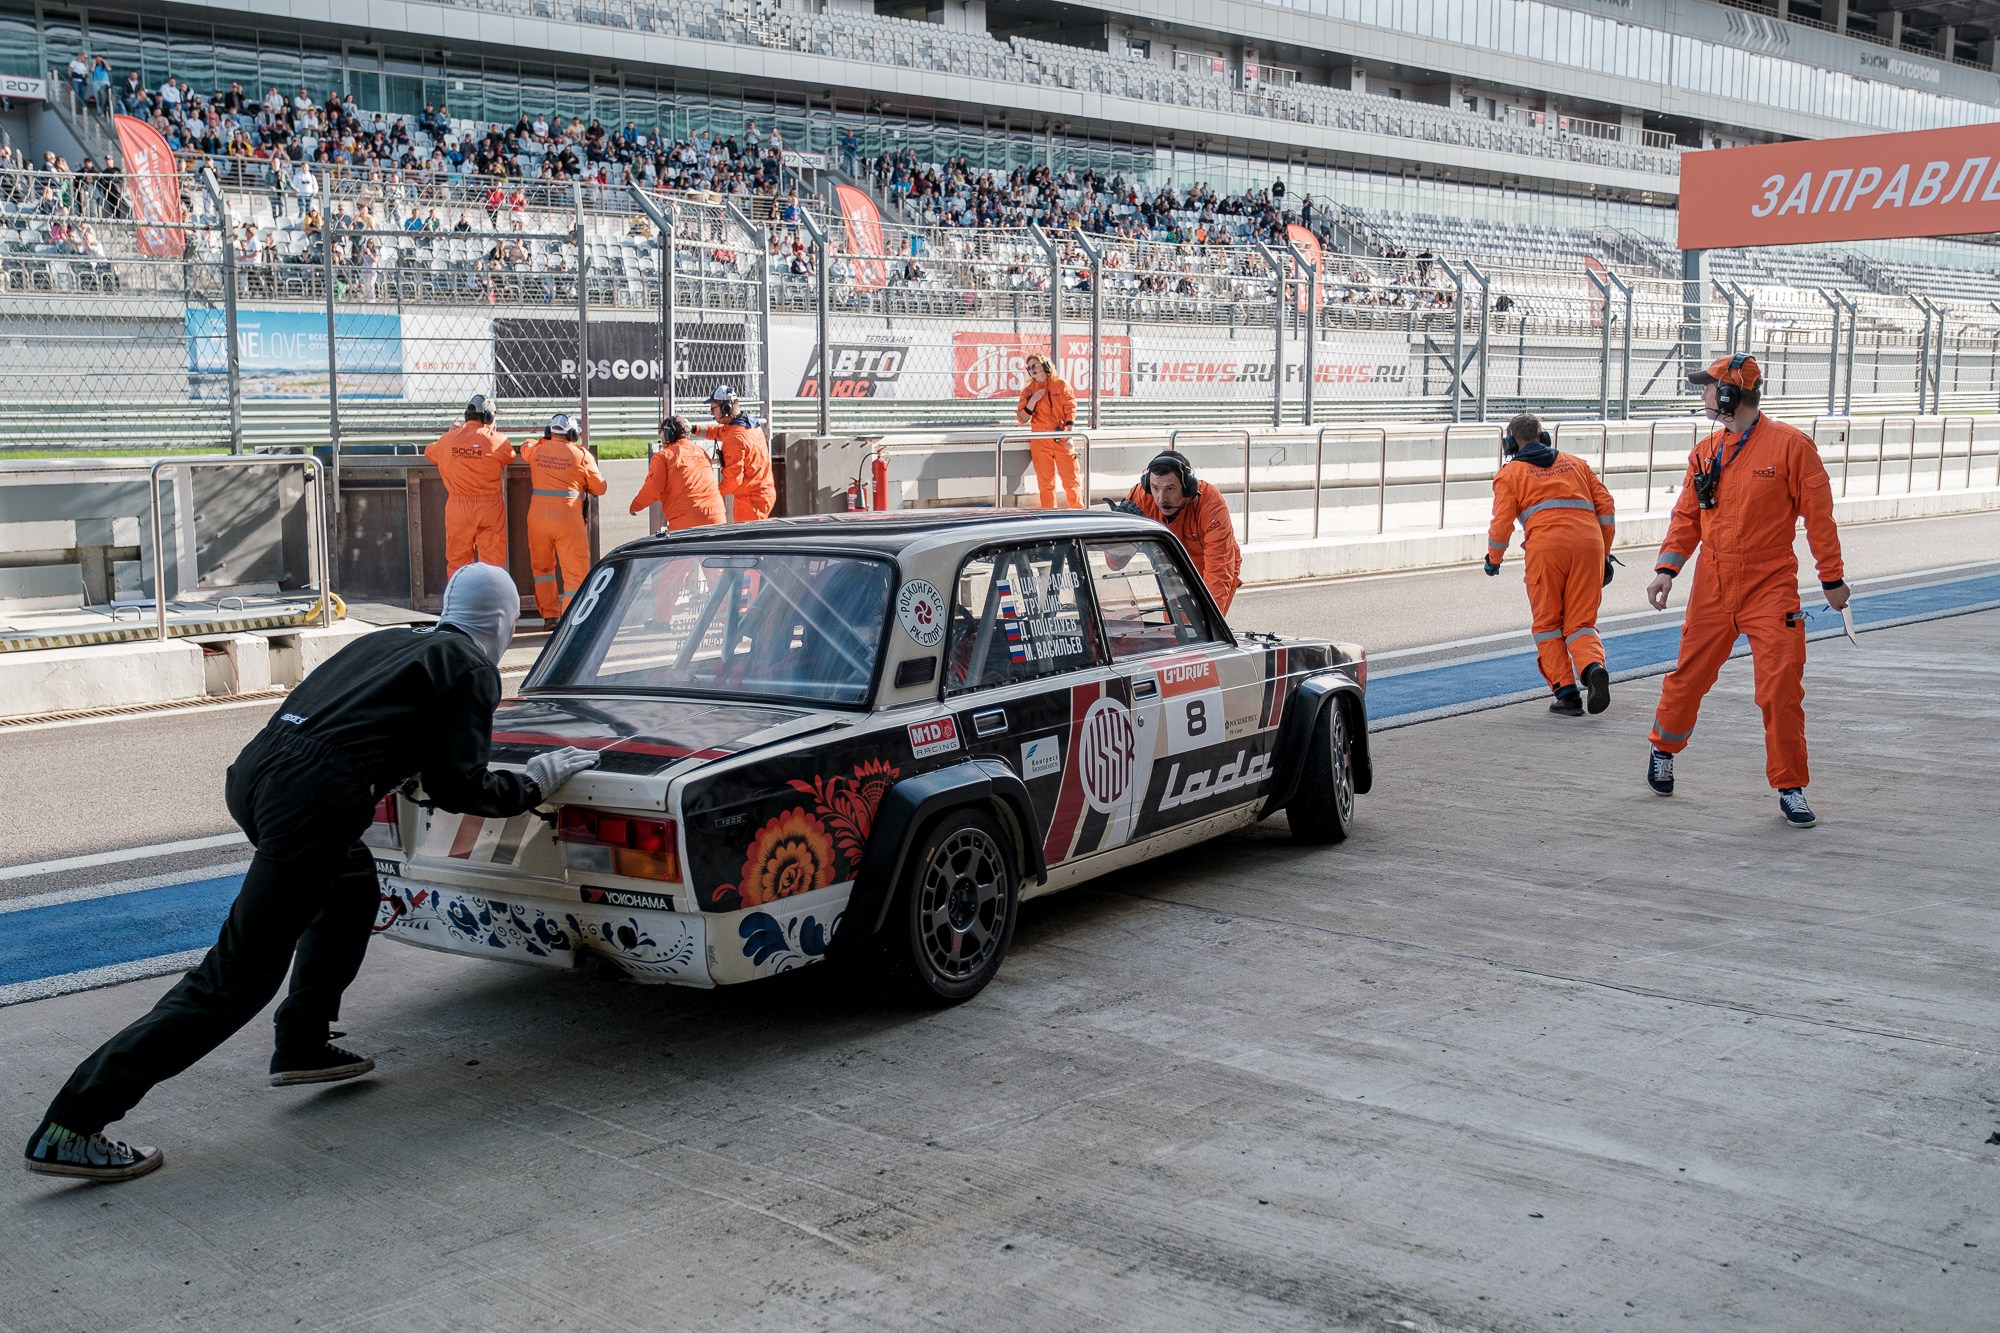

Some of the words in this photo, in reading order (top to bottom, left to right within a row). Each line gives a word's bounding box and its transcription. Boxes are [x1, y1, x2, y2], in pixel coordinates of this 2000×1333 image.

[6, 80, 40, 93] 207
[865, 335, 912, 344] ТЕЛЕКАНАЛ
[1136, 361, 1276, 382] F1NEWS.RU
[451, 447, 482, 456] SOCHI
[571, 567, 615, 626] 8
[900, 582, 943, 613] РОСКОНГРЕСС
[910, 622, 944, 644] РК-СПОРТ
[1018, 621, 1031, 641] Д.
[1029, 616, 1078, 637] ПОЦЕЛУЕВ
[1023, 643, 1037, 661] М.
[1036, 636, 1083, 660] ВАСИЛЬЕВ
[1186, 700, 1207, 737] 8
[911, 724, 942, 744] M1D
[916, 741, 957, 757] RACING
[1158, 749, 1274, 812] Lada
[605, 891, 669, 910] YOKOHAMA
